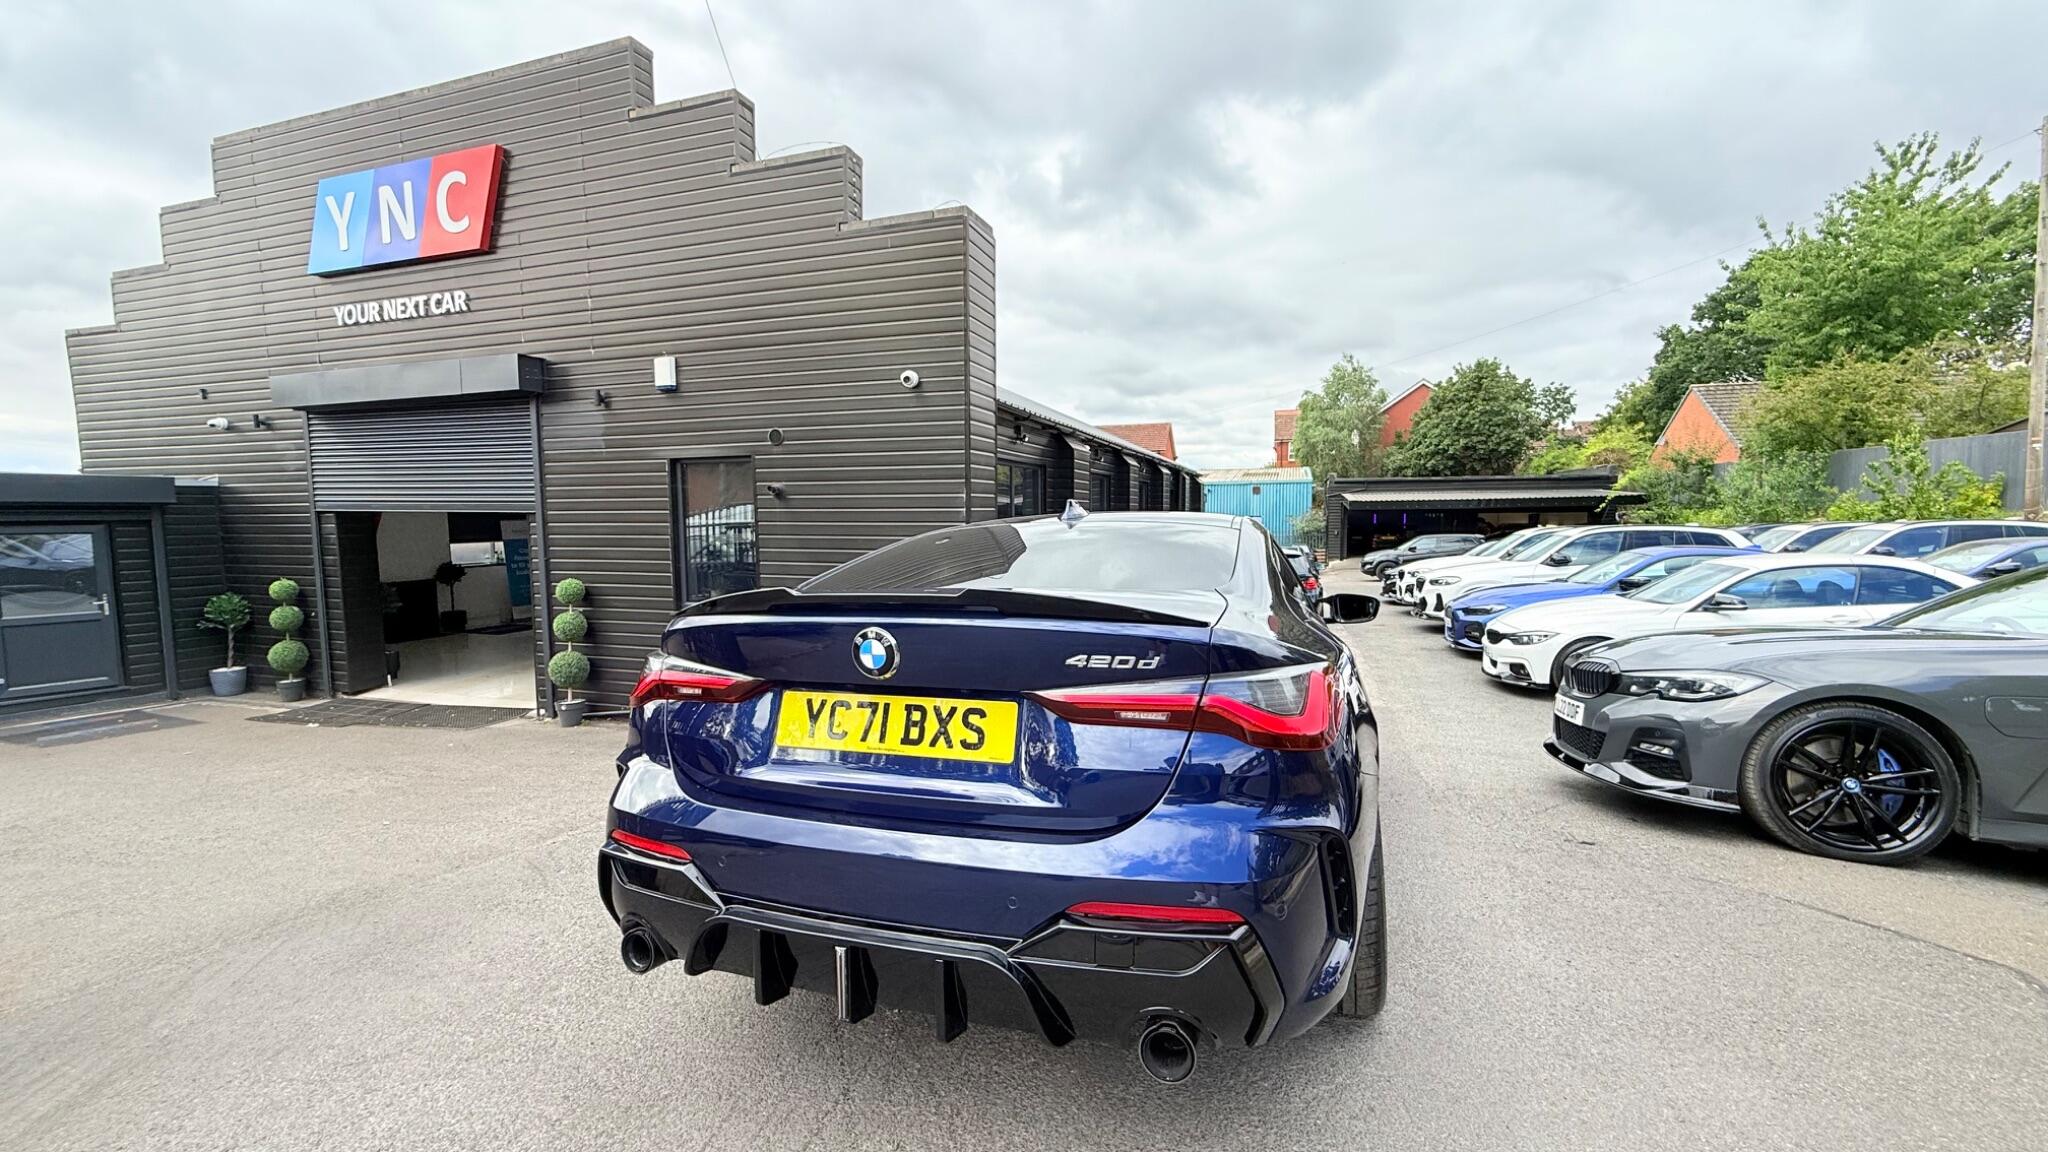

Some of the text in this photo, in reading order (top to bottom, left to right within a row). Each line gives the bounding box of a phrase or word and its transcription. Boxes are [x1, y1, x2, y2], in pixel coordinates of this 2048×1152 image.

[325, 170, 470, 251] YNC
[333, 290, 468, 326] YOUR NEXT CAR
[1065, 654, 1160, 670] 420d
[806, 698, 987, 751] YC71 BXS
